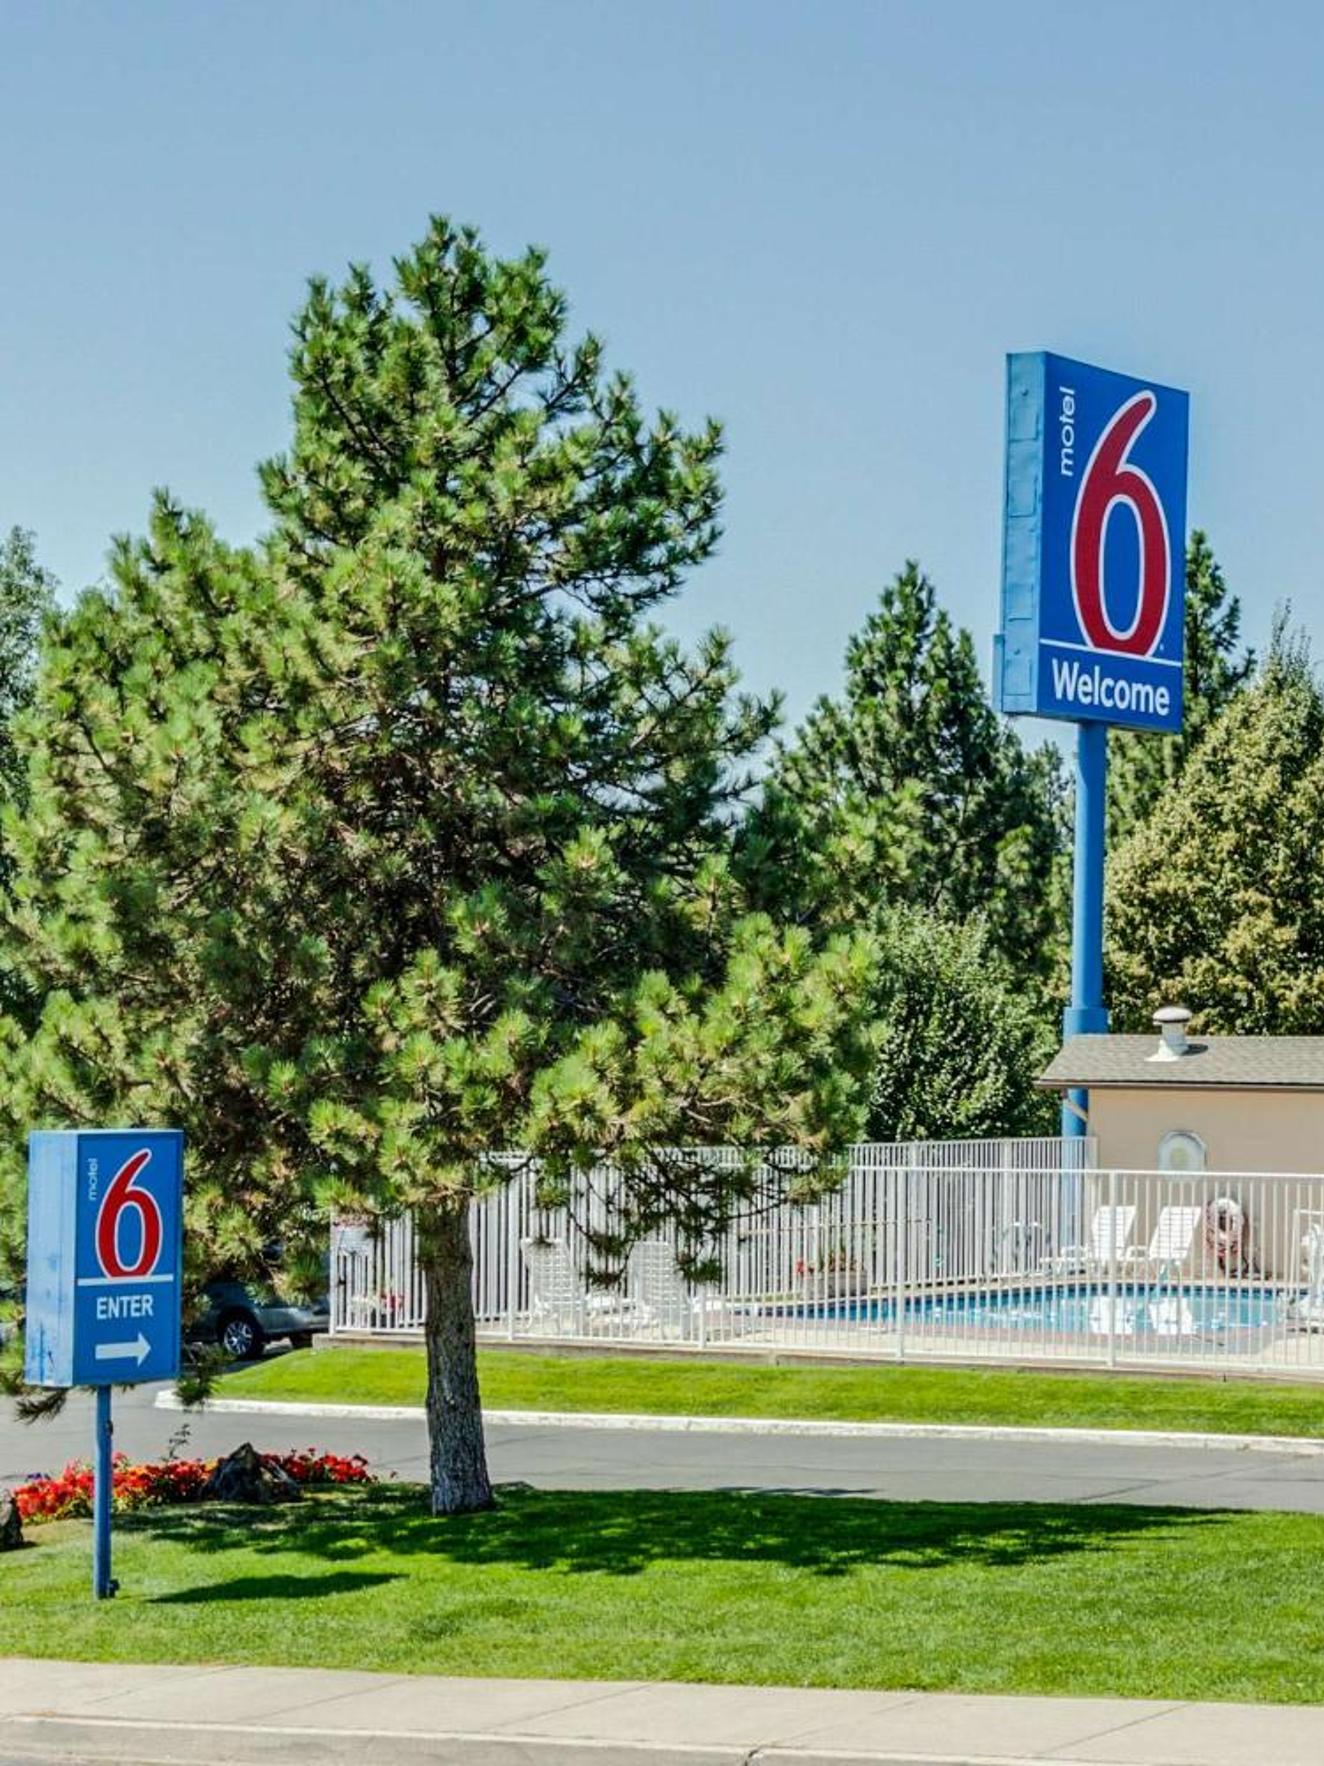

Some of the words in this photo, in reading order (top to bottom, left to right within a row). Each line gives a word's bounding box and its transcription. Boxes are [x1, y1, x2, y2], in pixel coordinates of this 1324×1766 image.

[1059, 386, 1076, 476] motel
[1070, 390, 1171, 658] 6
[1052, 658, 1170, 715] Welcome
[95, 1148, 163, 1279] 6
[96, 1295, 154, 1319] ENTER
